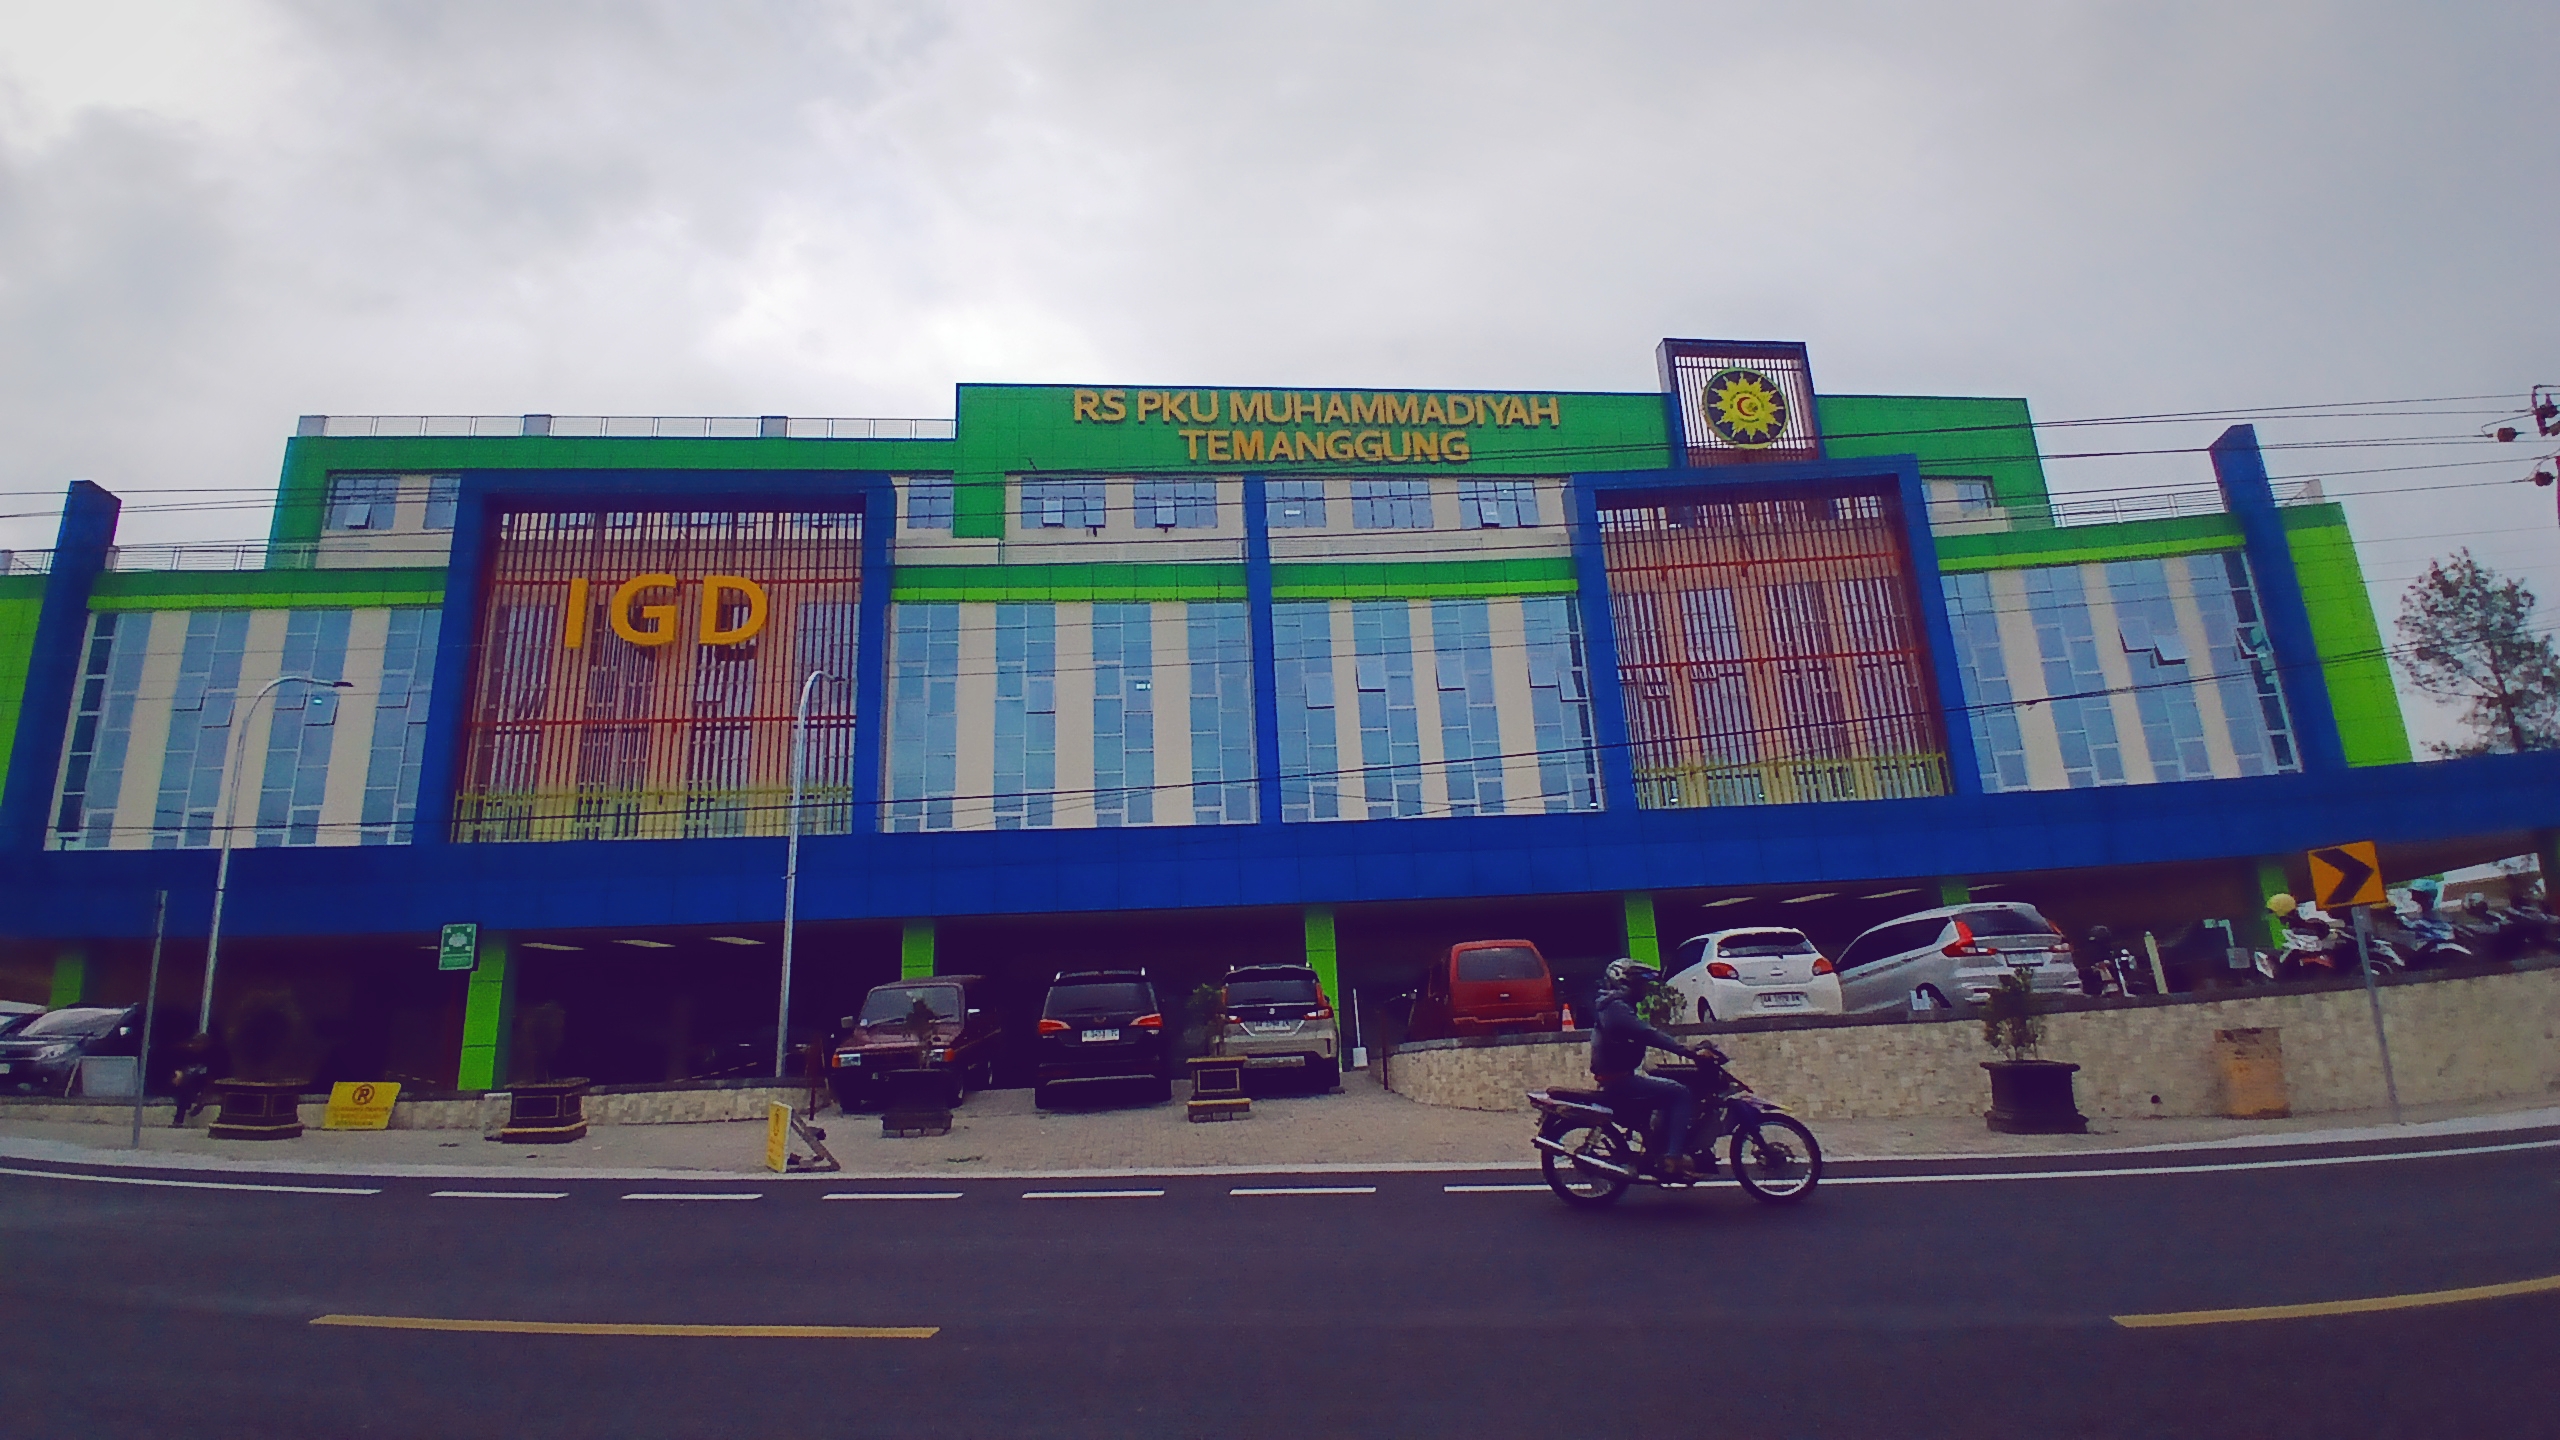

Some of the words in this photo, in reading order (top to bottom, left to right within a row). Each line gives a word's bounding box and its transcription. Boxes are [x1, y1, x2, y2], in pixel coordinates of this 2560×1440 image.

[1074, 389, 1126, 422] RS
[1138, 390, 1219, 423] PKU
[1230, 391, 1560, 426] MUHAMMADIYAH
[1178, 429, 1470, 462] TEMANGGUNG
[564, 573, 768, 649] IGD
